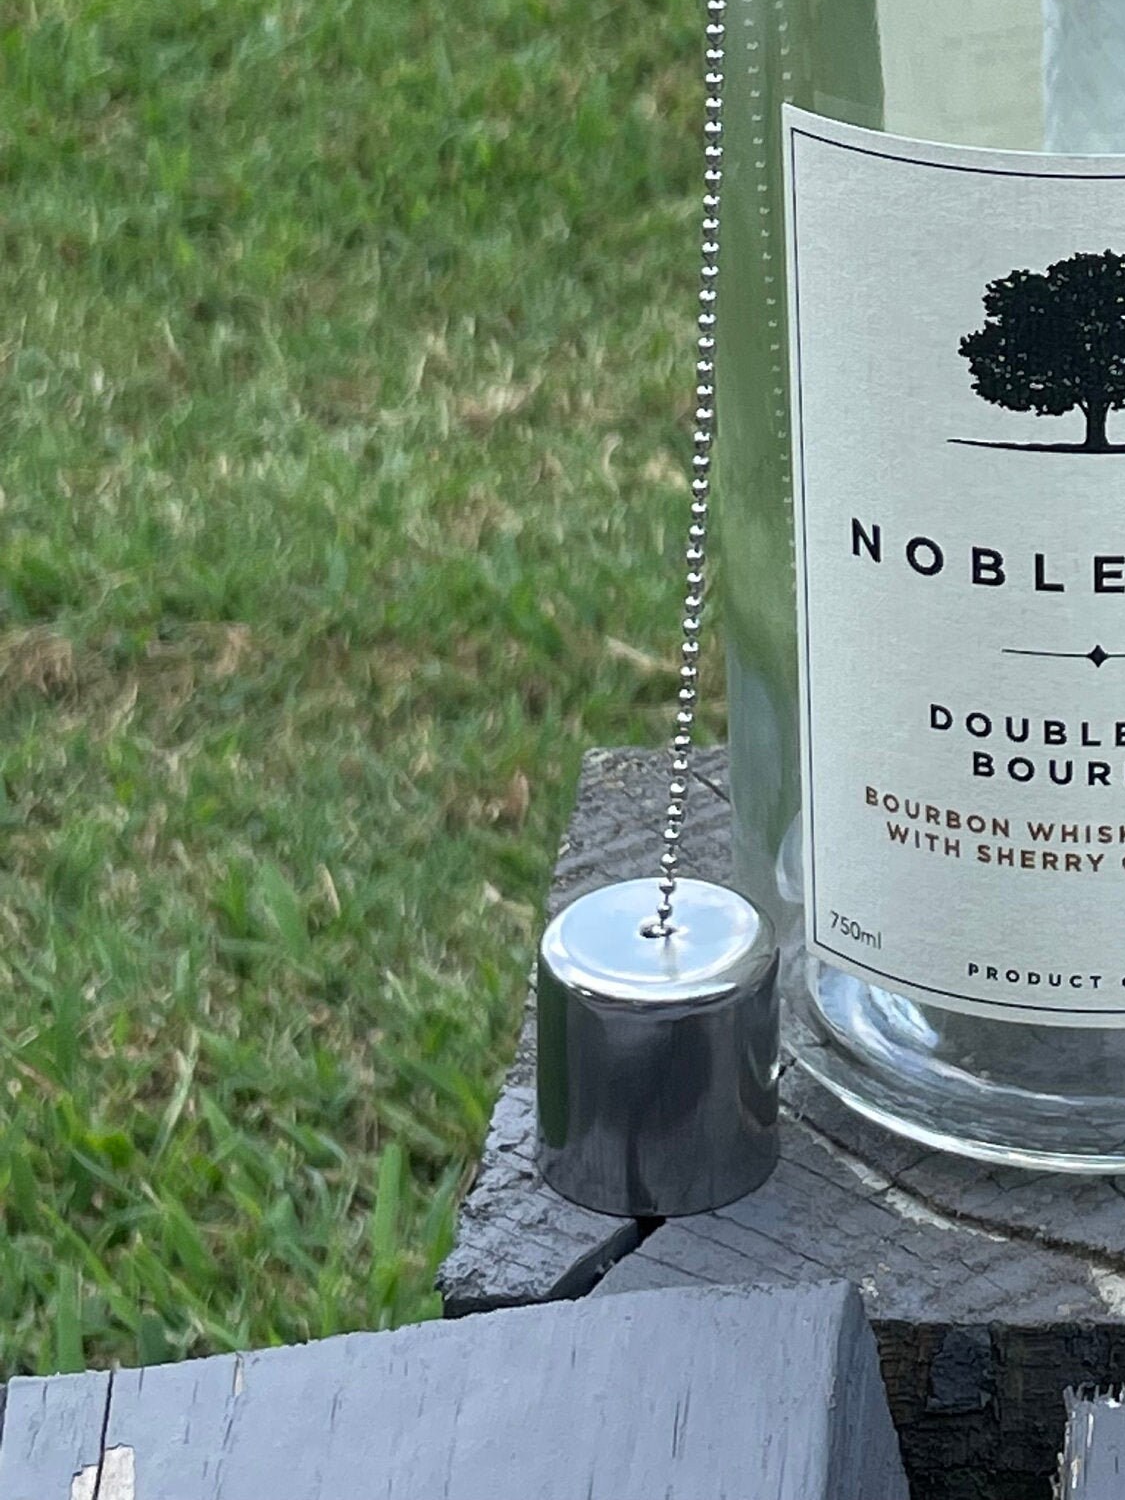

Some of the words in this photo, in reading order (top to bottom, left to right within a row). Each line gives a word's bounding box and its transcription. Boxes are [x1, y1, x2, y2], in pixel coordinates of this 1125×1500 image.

[852, 517, 1125, 594] NOBLE
[866, 786, 1009, 838] BOURBON
[887, 822, 961, 858] WITH
[977, 845, 1104, 872] SHERRY
[830, 910, 881, 950] 750ml
[968, 963, 1102, 988] PRODUCT
